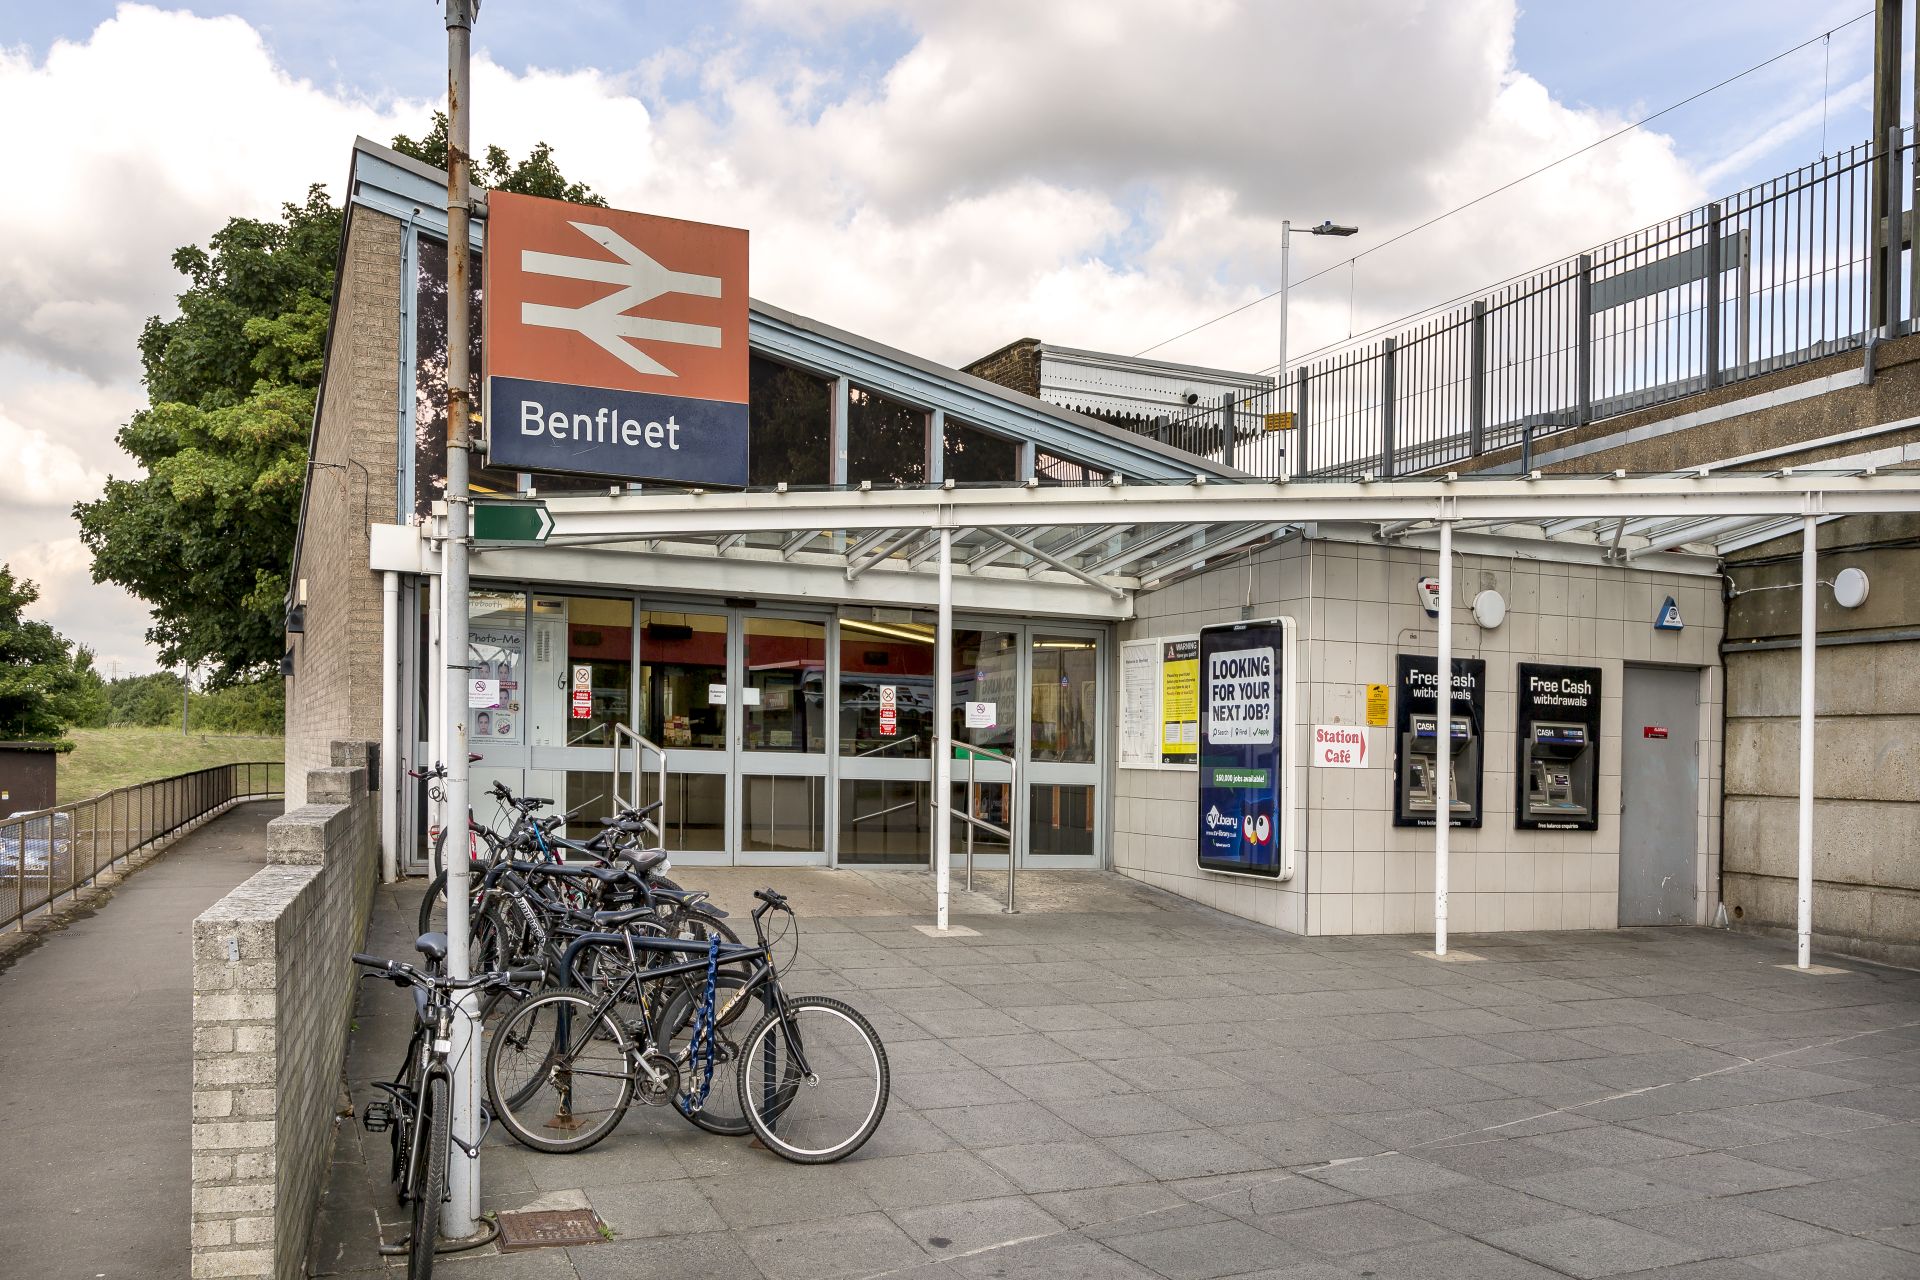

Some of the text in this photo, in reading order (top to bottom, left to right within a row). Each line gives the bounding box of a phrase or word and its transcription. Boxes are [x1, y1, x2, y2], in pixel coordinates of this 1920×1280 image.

[520, 400, 680, 451] Benfleet
[1213, 656, 1270, 680] LOOKING
[1410, 669, 1475, 687] Free ash
[1530, 676, 1592, 694] Free Cash
[1213, 684, 1235, 701] FOR
[1239, 681, 1270, 700] YOUR
[1413, 686, 1471, 700] withwals
[508, 703, 519, 711] £5
[1533, 693, 1588, 707] withdrawals
[1212, 705, 1240, 721] NEXT
[1243, 703, 1270, 720] JOB?
[1416, 722, 1435, 731] CASH
[1537, 728, 1554, 736] CASH
[1316, 729, 1359, 743] Station
[1325, 749, 1351, 763] Café
[1233, 774, 1243, 784] jobs
[714, 986, 746, 1021] EAGLE
